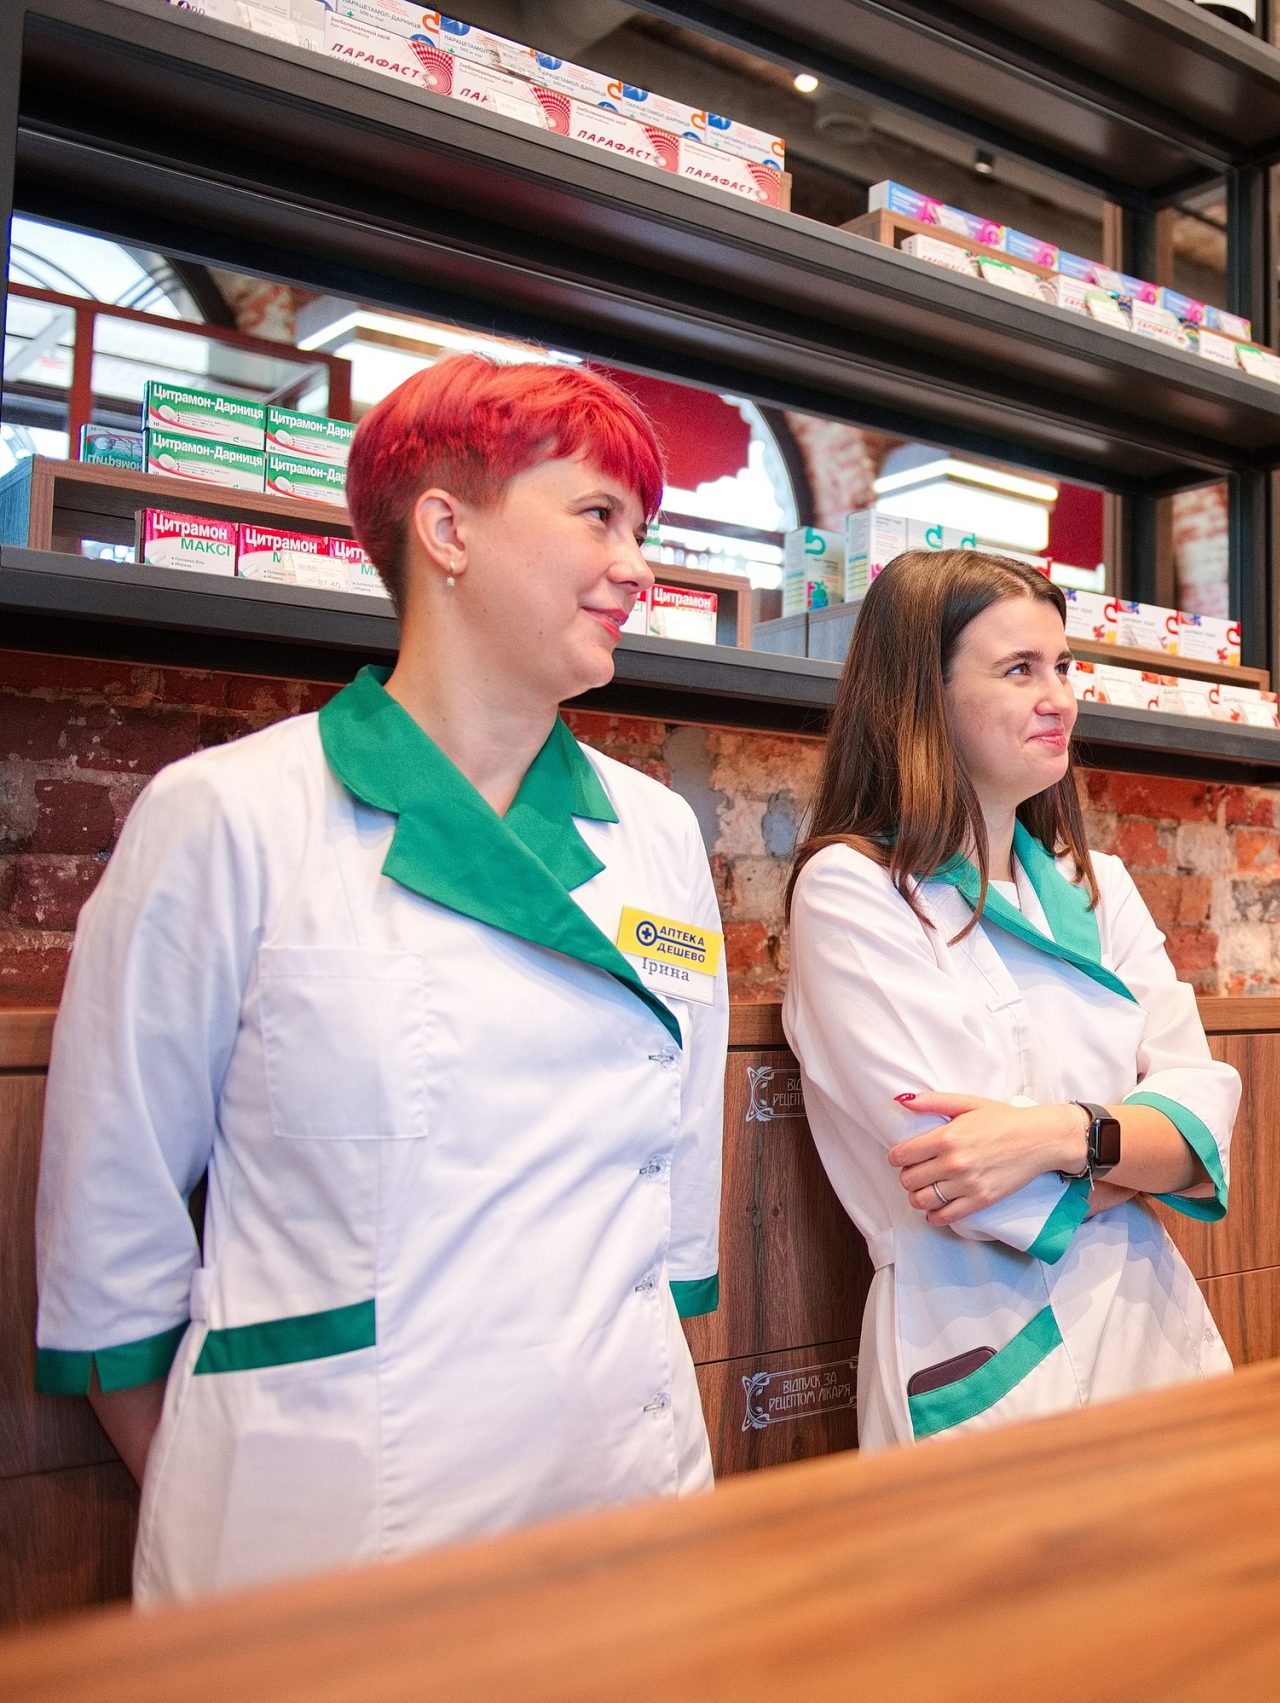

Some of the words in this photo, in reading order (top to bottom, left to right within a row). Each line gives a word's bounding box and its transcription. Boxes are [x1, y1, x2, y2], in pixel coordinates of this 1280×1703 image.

[331, 42, 420, 79] ПАРАФАСТ
[577, 129, 652, 160] ПАРАФАСТ
[685, 165, 753, 195] ПАРАФАСТ
[153, 383, 265, 420] Цитрамон-Дарниця
[270, 409, 354, 439] Цитрамон-Дарн
[152, 432, 264, 468] Цитрамон-Дарниця
[270, 456, 348, 485] Цитрамон-Дар
[153, 512, 229, 541] Цитрамон
[180, 537, 231, 557] МАКСІ
[245, 528, 319, 555] Цитрамон
[335, 540, 370, 564] Цитр
[654, 587, 711, 609] Цитрамон
[659, 925, 705, 947] АПТЕКА
[656, 942, 706, 964] ДЕШЕВО
[641, 957, 690, 982] Ірина
[772, 1092, 804, 1108] РЕЦЕПТ
[783, 1374, 821, 1394] ВІДПУСК
[823, 1371, 838, 1387] ЗА
[768, 1390, 816, 1412] РЕЦЕПТОМ
[818, 1383, 851, 1402] ЛІКАРЯ
